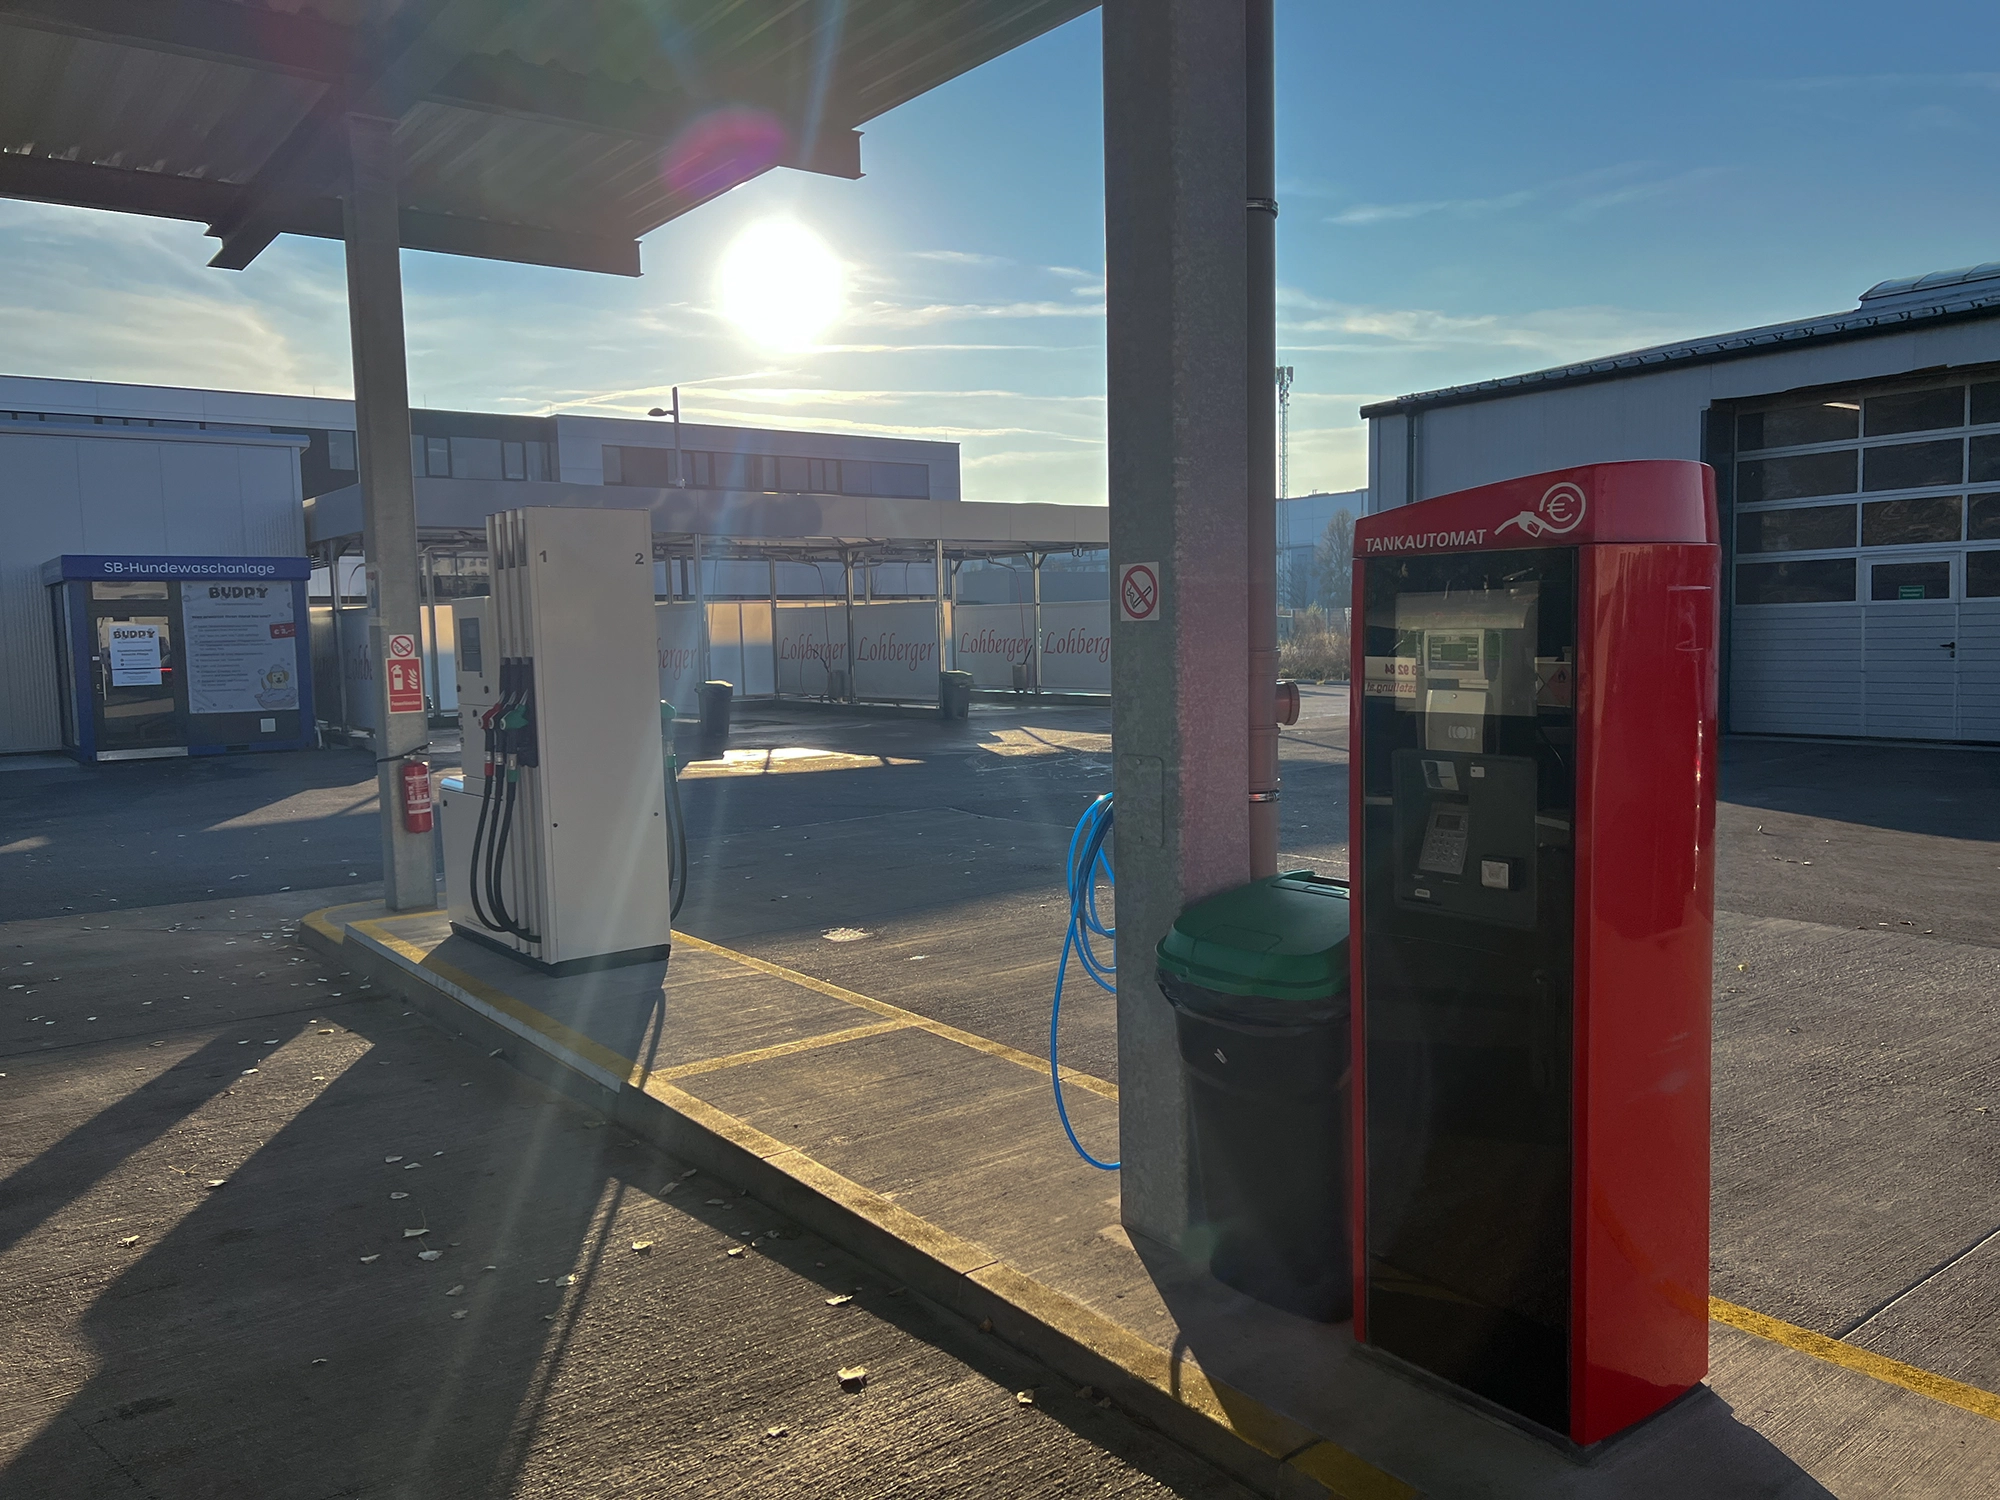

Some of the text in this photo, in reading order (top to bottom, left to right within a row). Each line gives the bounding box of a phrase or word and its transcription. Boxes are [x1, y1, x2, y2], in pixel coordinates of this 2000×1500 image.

[1365, 529, 1487, 552] TANKAUTOMAT
[539, 550, 547, 563] 1
[634, 552, 645, 565] 2
[104, 562, 275, 576] SB-Hundewaschanlage
[208, 586, 269, 599] BUDDY
[113, 630, 155, 639] BUDDY
[959, 629, 1032, 662] Lohberger
[1043, 628, 1110, 663] Lohberg
[656, 637, 697, 680] berger
[780, 633, 846, 671] Lohberger
[857, 632, 935, 671] Lohberger
